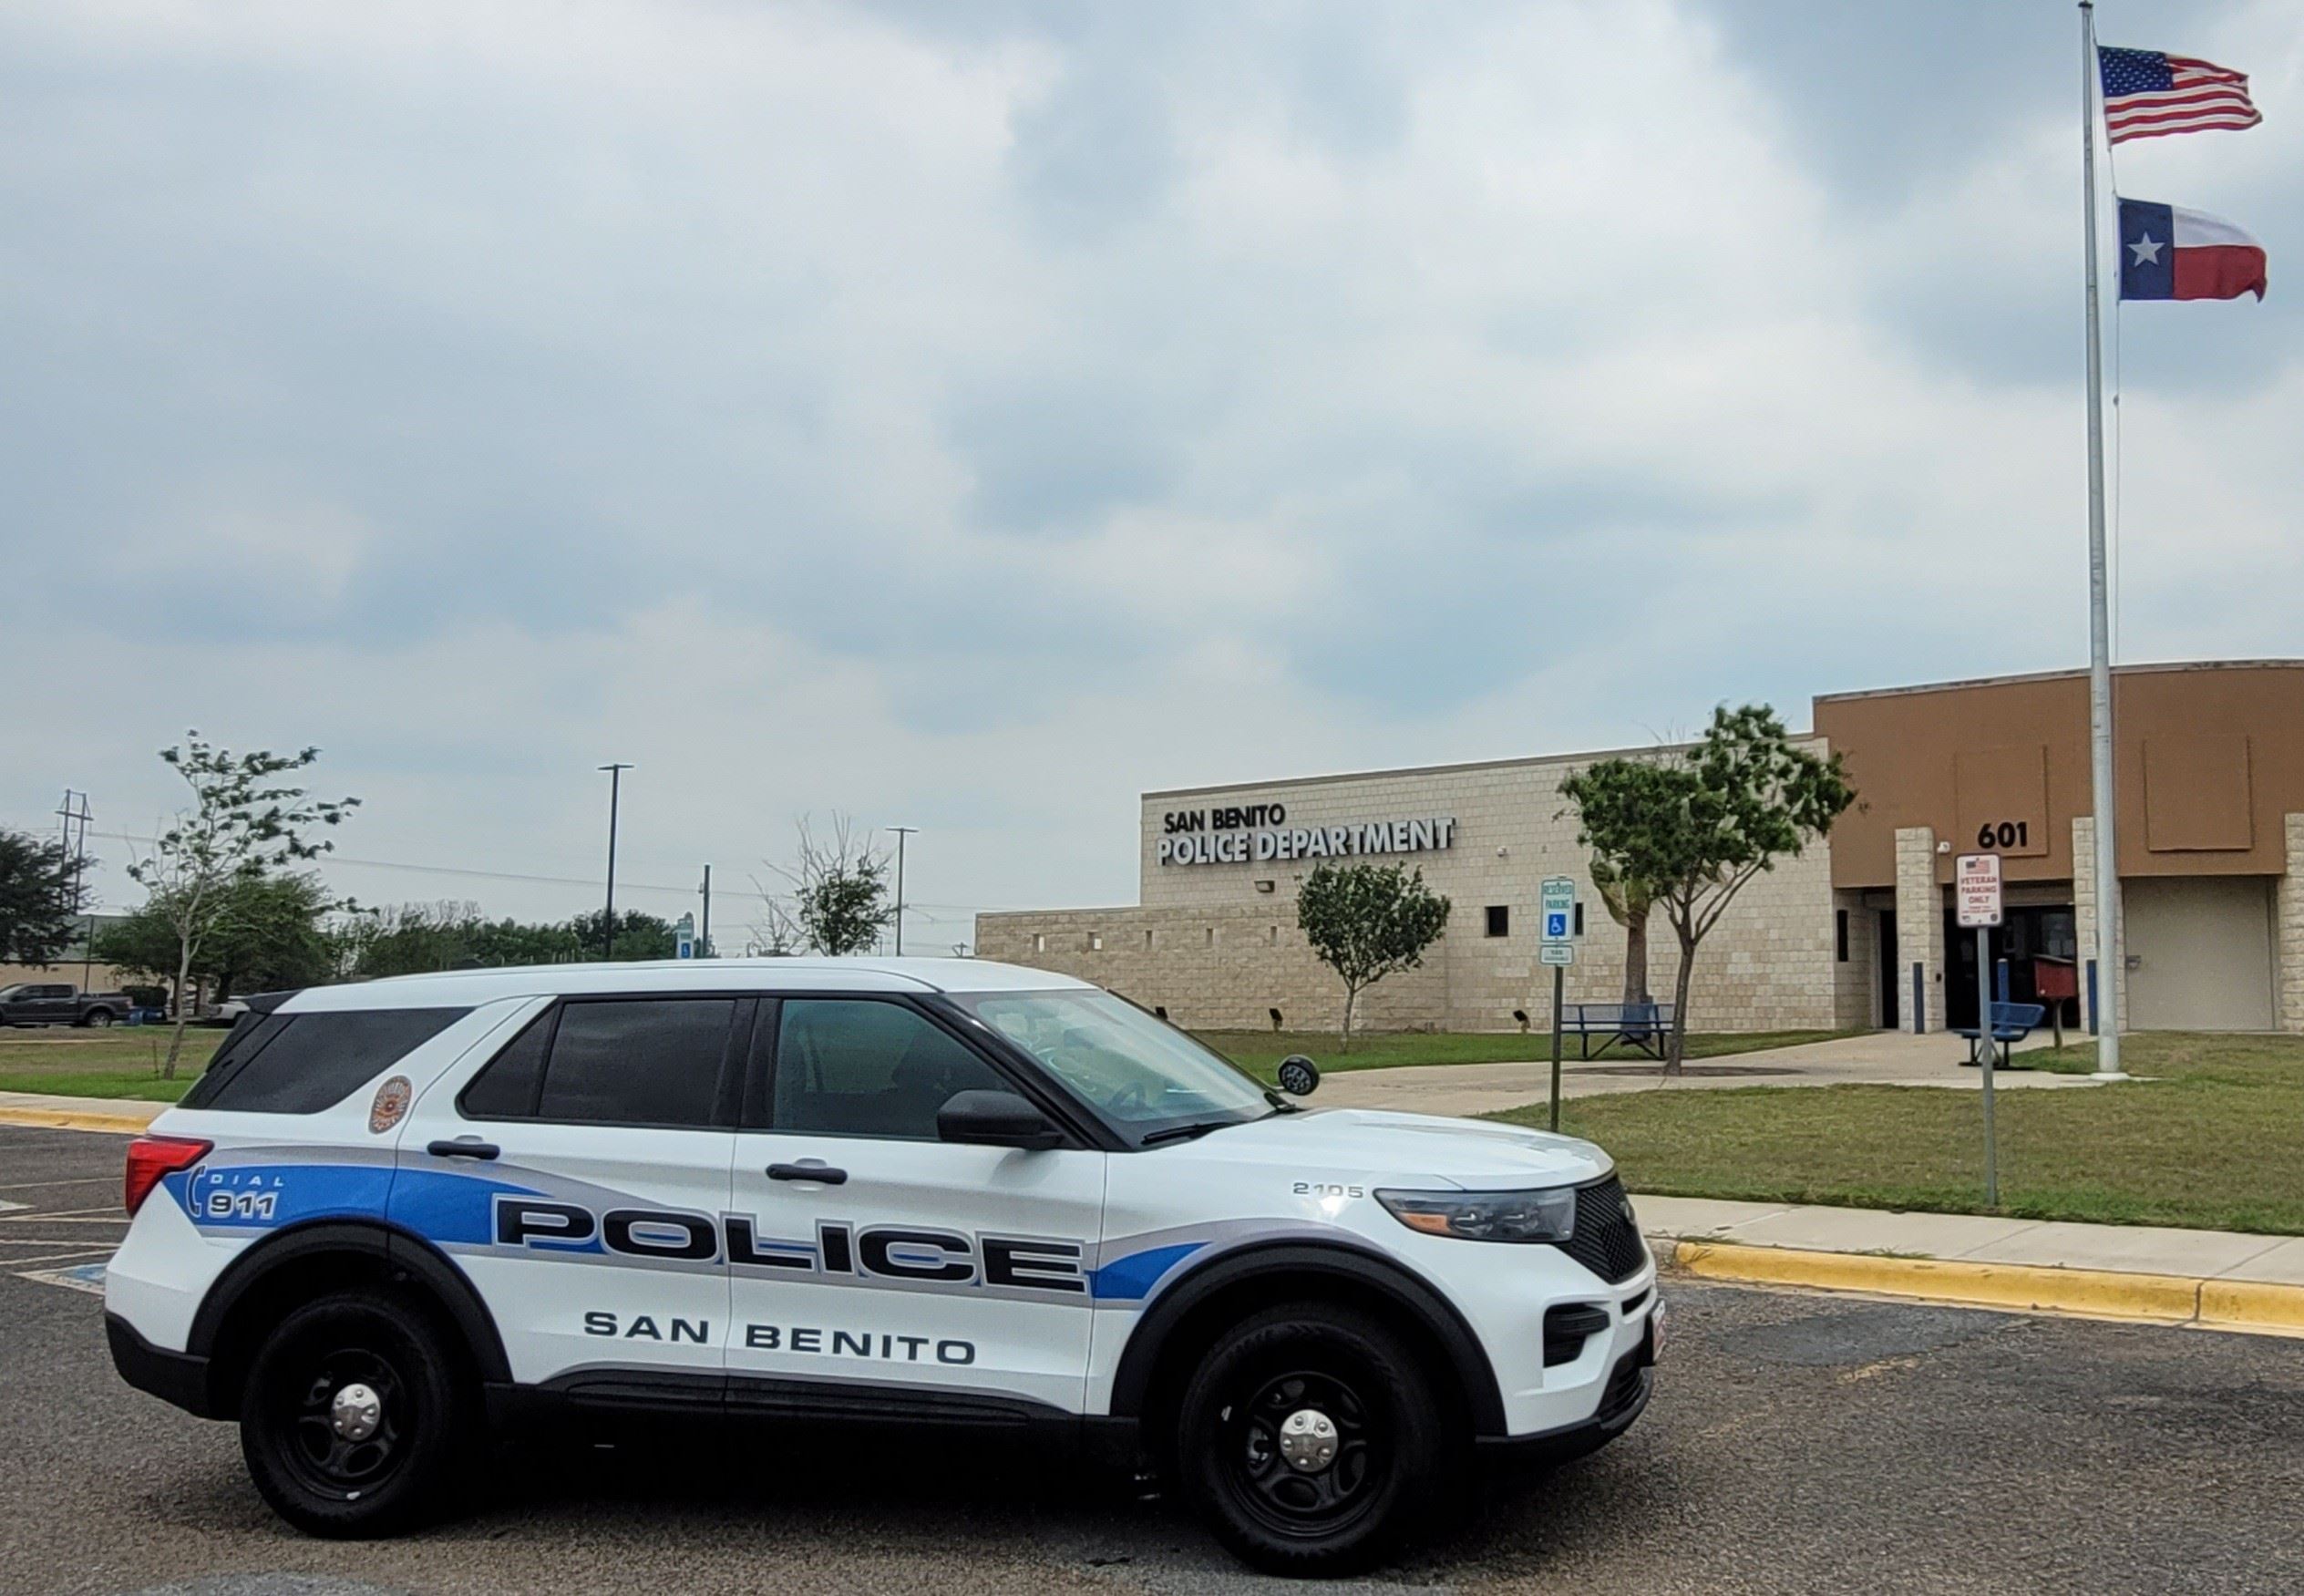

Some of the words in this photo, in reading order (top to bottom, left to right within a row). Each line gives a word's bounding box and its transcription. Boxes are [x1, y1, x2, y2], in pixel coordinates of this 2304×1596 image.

[1164, 809, 1205, 834] SAN
[1212, 803, 1287, 830] BENITO
[1157, 833, 1250, 866] POLICE
[1256, 818, 1456, 861] DEPARTMENT
[1978, 821, 2027, 849] 601
[1960, 876, 1997, 885] VETERAN
[1960, 886, 1997, 894] PARKING
[1968, 895, 1990, 904] ONLY
[210, 1173, 284, 1187] DIAL
[1292, 1181, 1364, 1199] 2105
[209, 1191, 276, 1218] 911
[493, 1195, 1090, 1294] POLICE
[584, 1311, 709, 1344] SAN
[745, 1323, 976, 1365] BENITO
